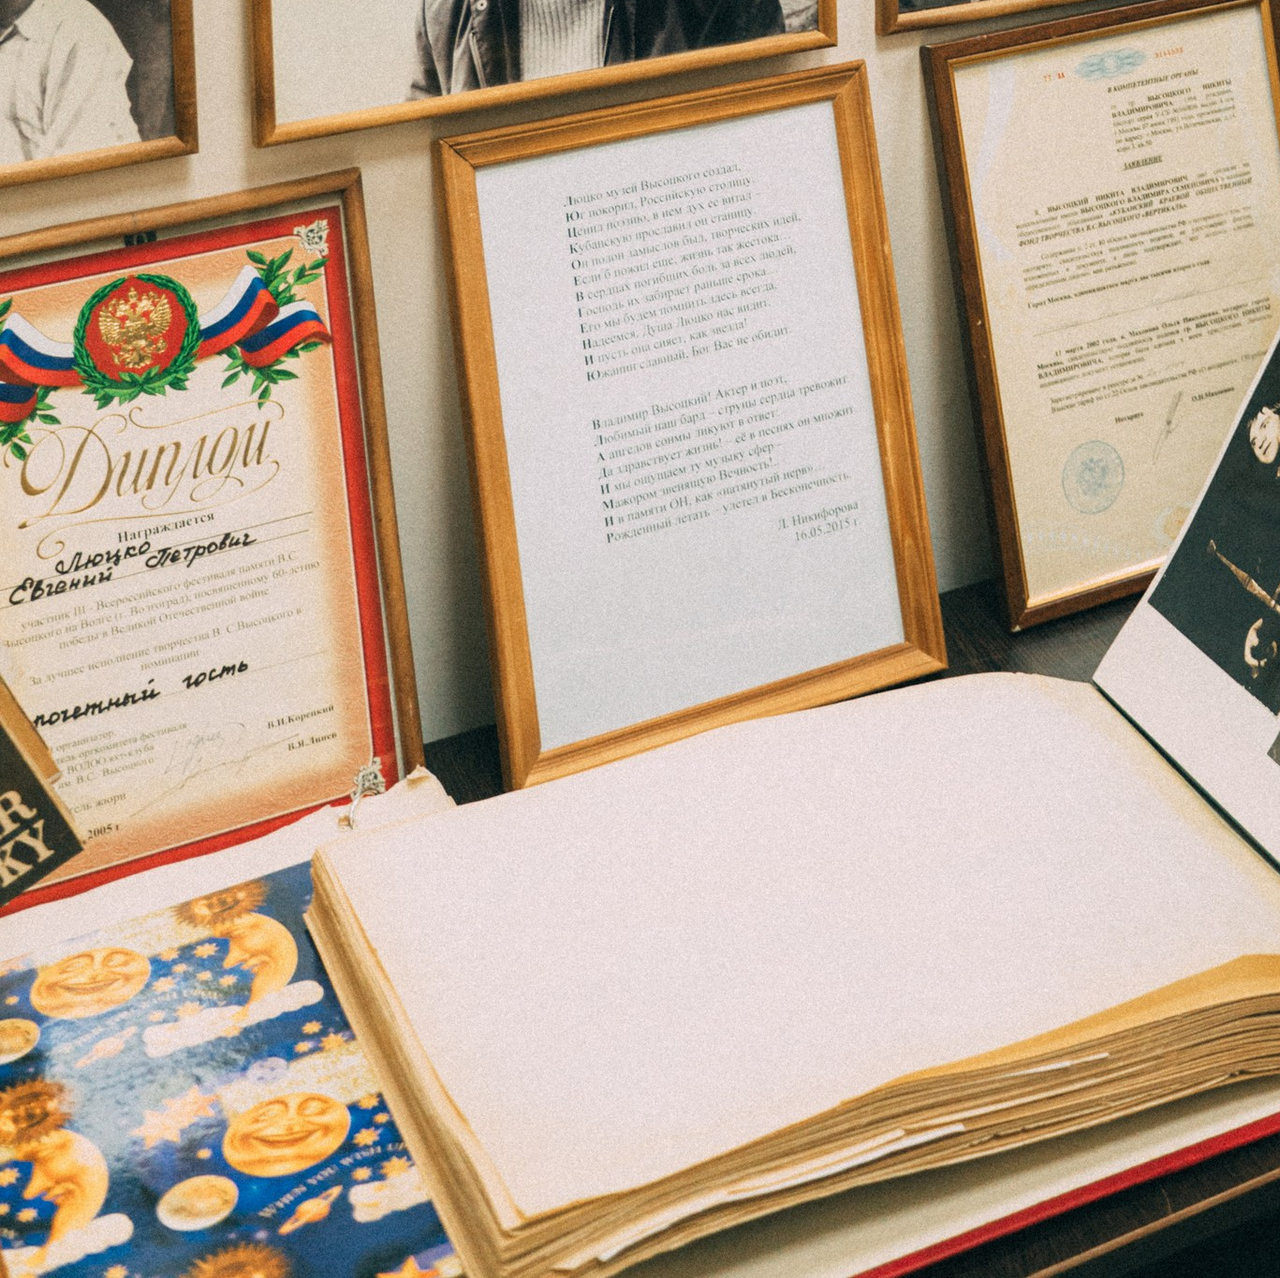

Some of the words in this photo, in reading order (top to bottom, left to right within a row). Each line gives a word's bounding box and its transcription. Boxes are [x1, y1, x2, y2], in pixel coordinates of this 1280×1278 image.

[562, 192, 603, 206] Люцко
[605, 182, 638, 198] музей
[640, 172, 700, 190] Высоцкого
[639, 187, 706, 206] Российскую
[567, 224, 603, 239] Ценил
[721, 193, 752, 205] витал
[569, 234, 632, 254] Кубанскую
[634, 222, 691, 241] прославил
[694, 218, 707, 227] он
[571, 258, 588, 269] Он
[591, 252, 624, 265] полон
[628, 240, 679, 257] замыслов
[710, 221, 769, 239] творческих
[573, 273, 601, 285] Если
[613, 263, 649, 276] пожил
[679, 249, 713, 262] жизнь
[575, 290, 584, 301] В
[587, 283, 630, 299] сердцах
[633, 270, 688, 288] погибших
[691, 264, 717, 275] боль
[733, 255, 755, 266] всех
[577, 301, 624, 317] Господь
[644, 286, 690, 302] забирает
[693, 276, 733, 293] раньше
[579, 322, 600, 333] Его
[622, 310, 656, 324] будем
[659, 298, 706, 315] помнить
[641, 322, 672, 337] Душа
[675, 313, 713, 327] Люцко
[583, 354, 593, 365] И
[630, 343, 650, 353] она
[689, 329, 708, 340] как
[585, 363, 636, 381] Южанин
[691, 345, 710, 355] Бог
[591, 410, 649, 429] Владимир
[651, 391, 711, 415] Высоцкий!
[715, 385, 748, 399] Актер
[593, 423, 651, 446] Любимый
[654, 419, 677, 431] наш
[679, 412, 706, 424] бард
[717, 399, 756, 415] струны
[759, 390, 795, 404] сердца
[597, 467, 613, 480] Да
[617, 451, 681, 473] здравствует
[684, 437, 722, 456] жизнь!
[758, 422, 794, 436] песнях
[797, 418, 810, 427] он
[608, 442, 652, 459] ангелов
[655, 432, 691, 447] сонмы
[695, 421, 734, 436] ликуют
[599, 483, 610, 494] И
[633, 466, 686, 486] ощущаем
[704, 451, 745, 468] музыку
[748, 443, 774, 457] сфер
[602, 490, 657, 510] Мажором
[661, 474, 716, 495] звенящую
[604, 515, 614, 527] И
[627, 504, 666, 520] памяти
[695, 492, 712, 502] как
[118, 513, 215, 543] Награждается
[606, 517, 671, 543] Рожденный
[674, 509, 710, 524] летать
[722, 496, 758, 514] улетел
[792, 501, 858, 525] Никифорова
[795, 517, 850, 541] 16.05.2015
[8, 566, 114, 606] Евгений
[145, 533, 257, 569] Петрович
[55, 540, 151, 575] Люцко
[21, 611, 70, 632] участник
[96, 583, 181, 610] Всероссийского
[183, 569, 235, 590] фестиваля
[239, 559, 275, 573] памяти
[194, 574, 268, 599] посвященному
[59, 633, 98, 648] победы
[111, 616, 156, 635] Великой
[159, 595, 236, 622] Отечественной
[239, 588, 268, 601] войне
[87, 648, 149, 670] исполнение
[153, 632, 209, 652] творчества
[183, 660, 249, 690] гость
[78, 737, 137, 758] оргкомитета
[139, 723, 186, 743] фестиваля
[87, 824, 113, 841] 2005
